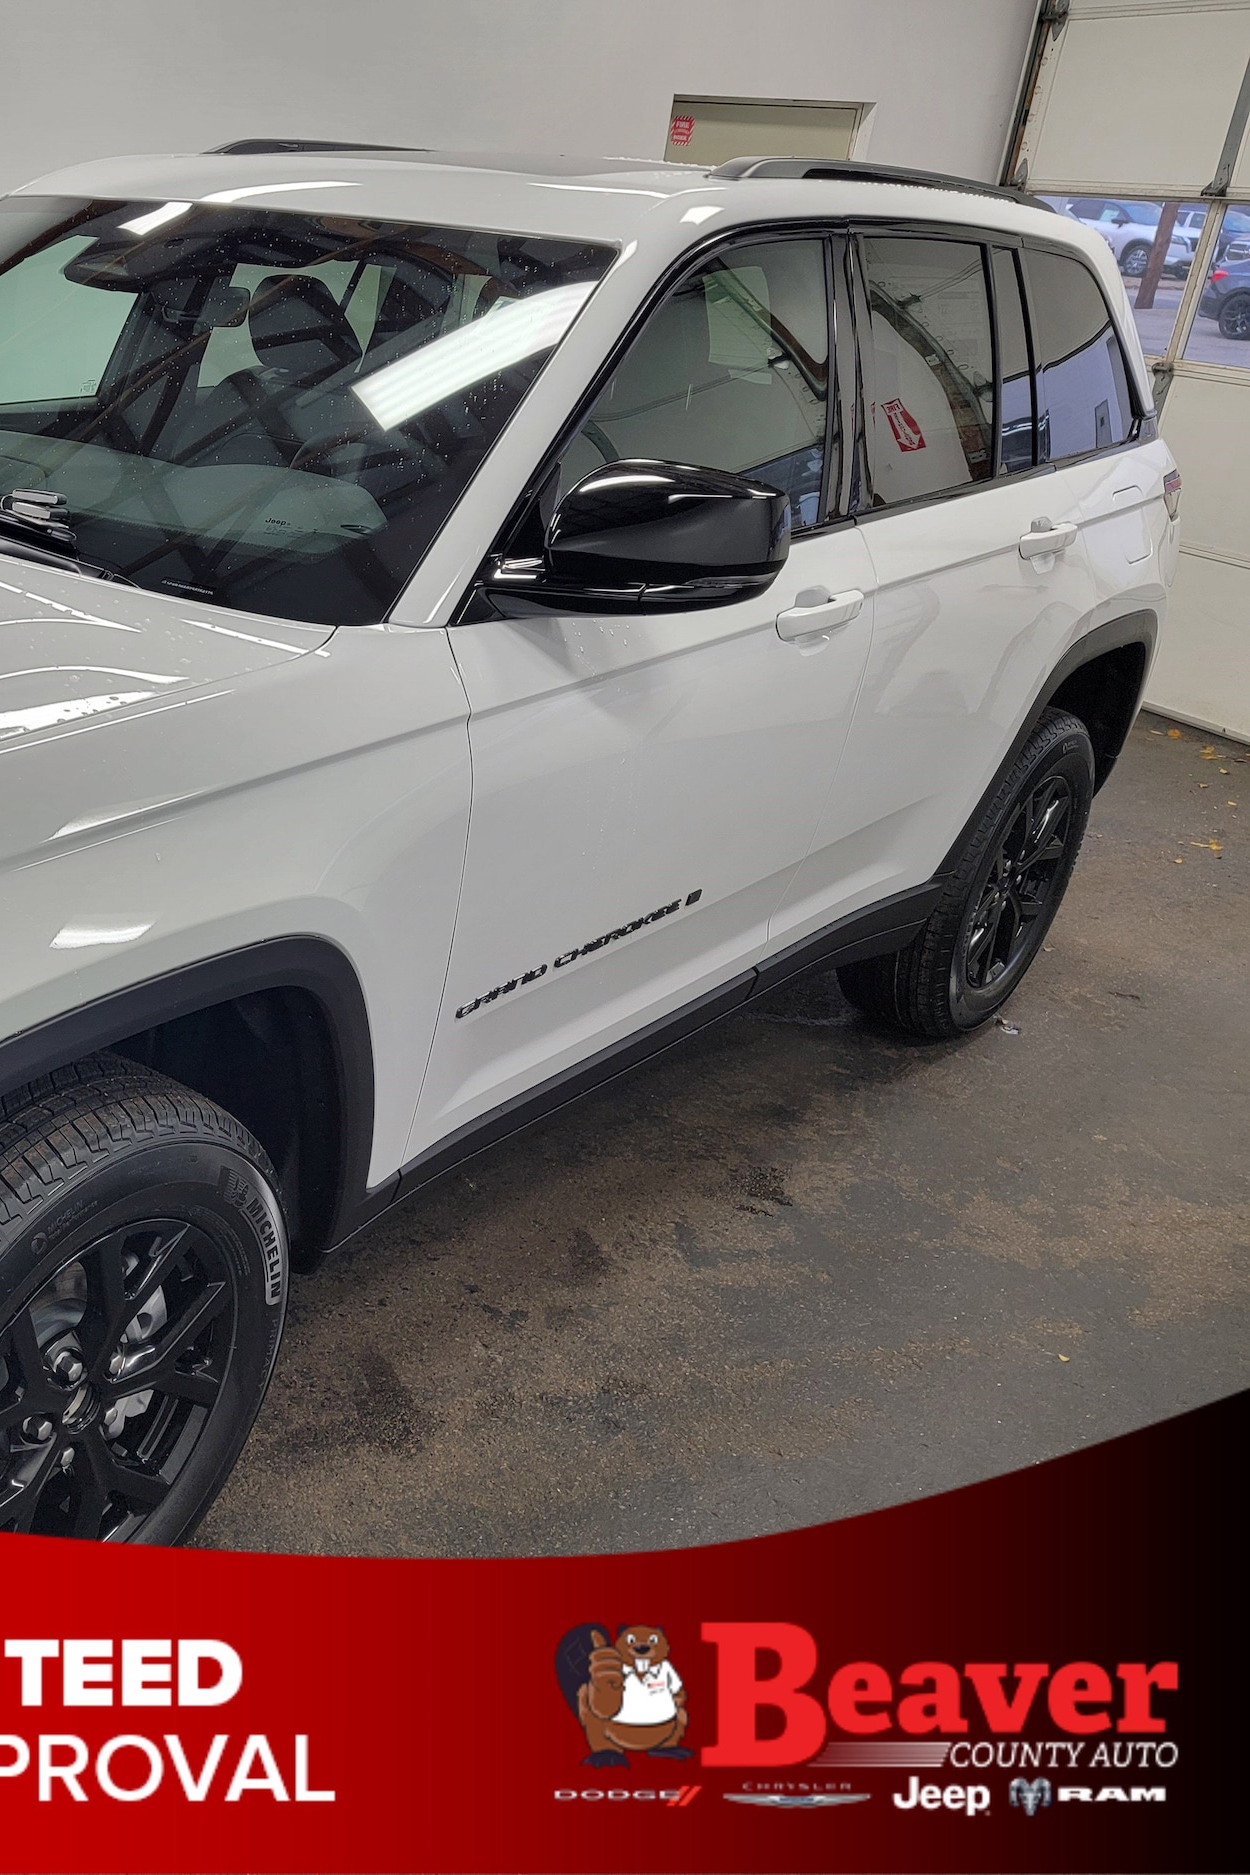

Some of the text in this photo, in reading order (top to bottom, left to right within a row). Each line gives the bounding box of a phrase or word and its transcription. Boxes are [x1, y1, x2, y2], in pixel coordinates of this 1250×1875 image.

[265, 517, 287, 526] Jeep
[455, 898, 683, 1020] GRAND CHEROKEE
[246, 1197, 281, 1298] MICHELIN
[258, 1318, 279, 1391] PRIMACY
